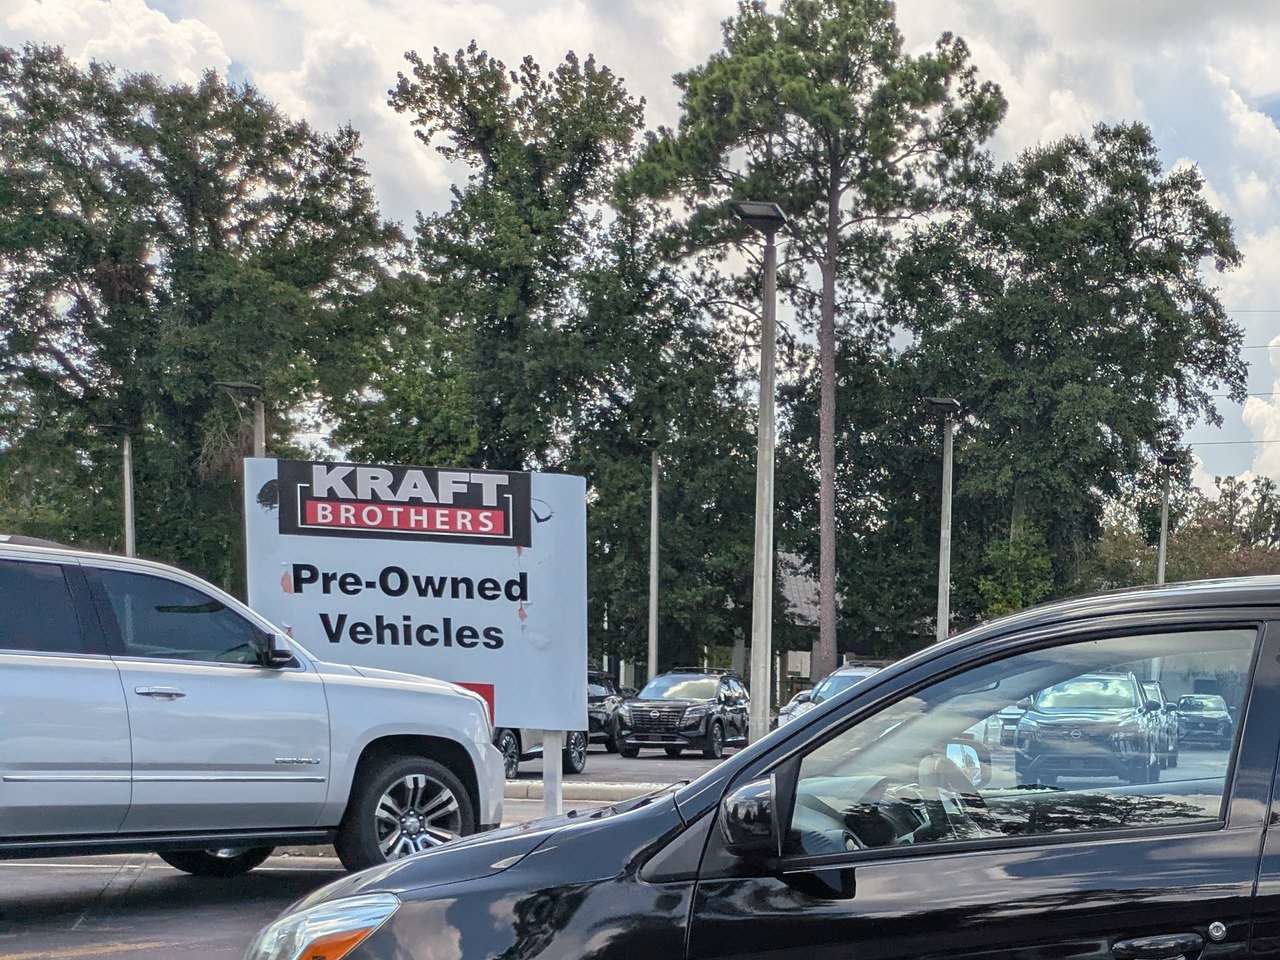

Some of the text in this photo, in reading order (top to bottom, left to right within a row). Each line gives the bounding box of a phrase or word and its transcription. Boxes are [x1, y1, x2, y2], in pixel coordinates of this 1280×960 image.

[312, 464, 509, 507] KRAFT
[316, 503, 494, 533] BROTHERS
[292, 563, 528, 602] Pre-Owned
[319, 613, 505, 650] Vehicles
